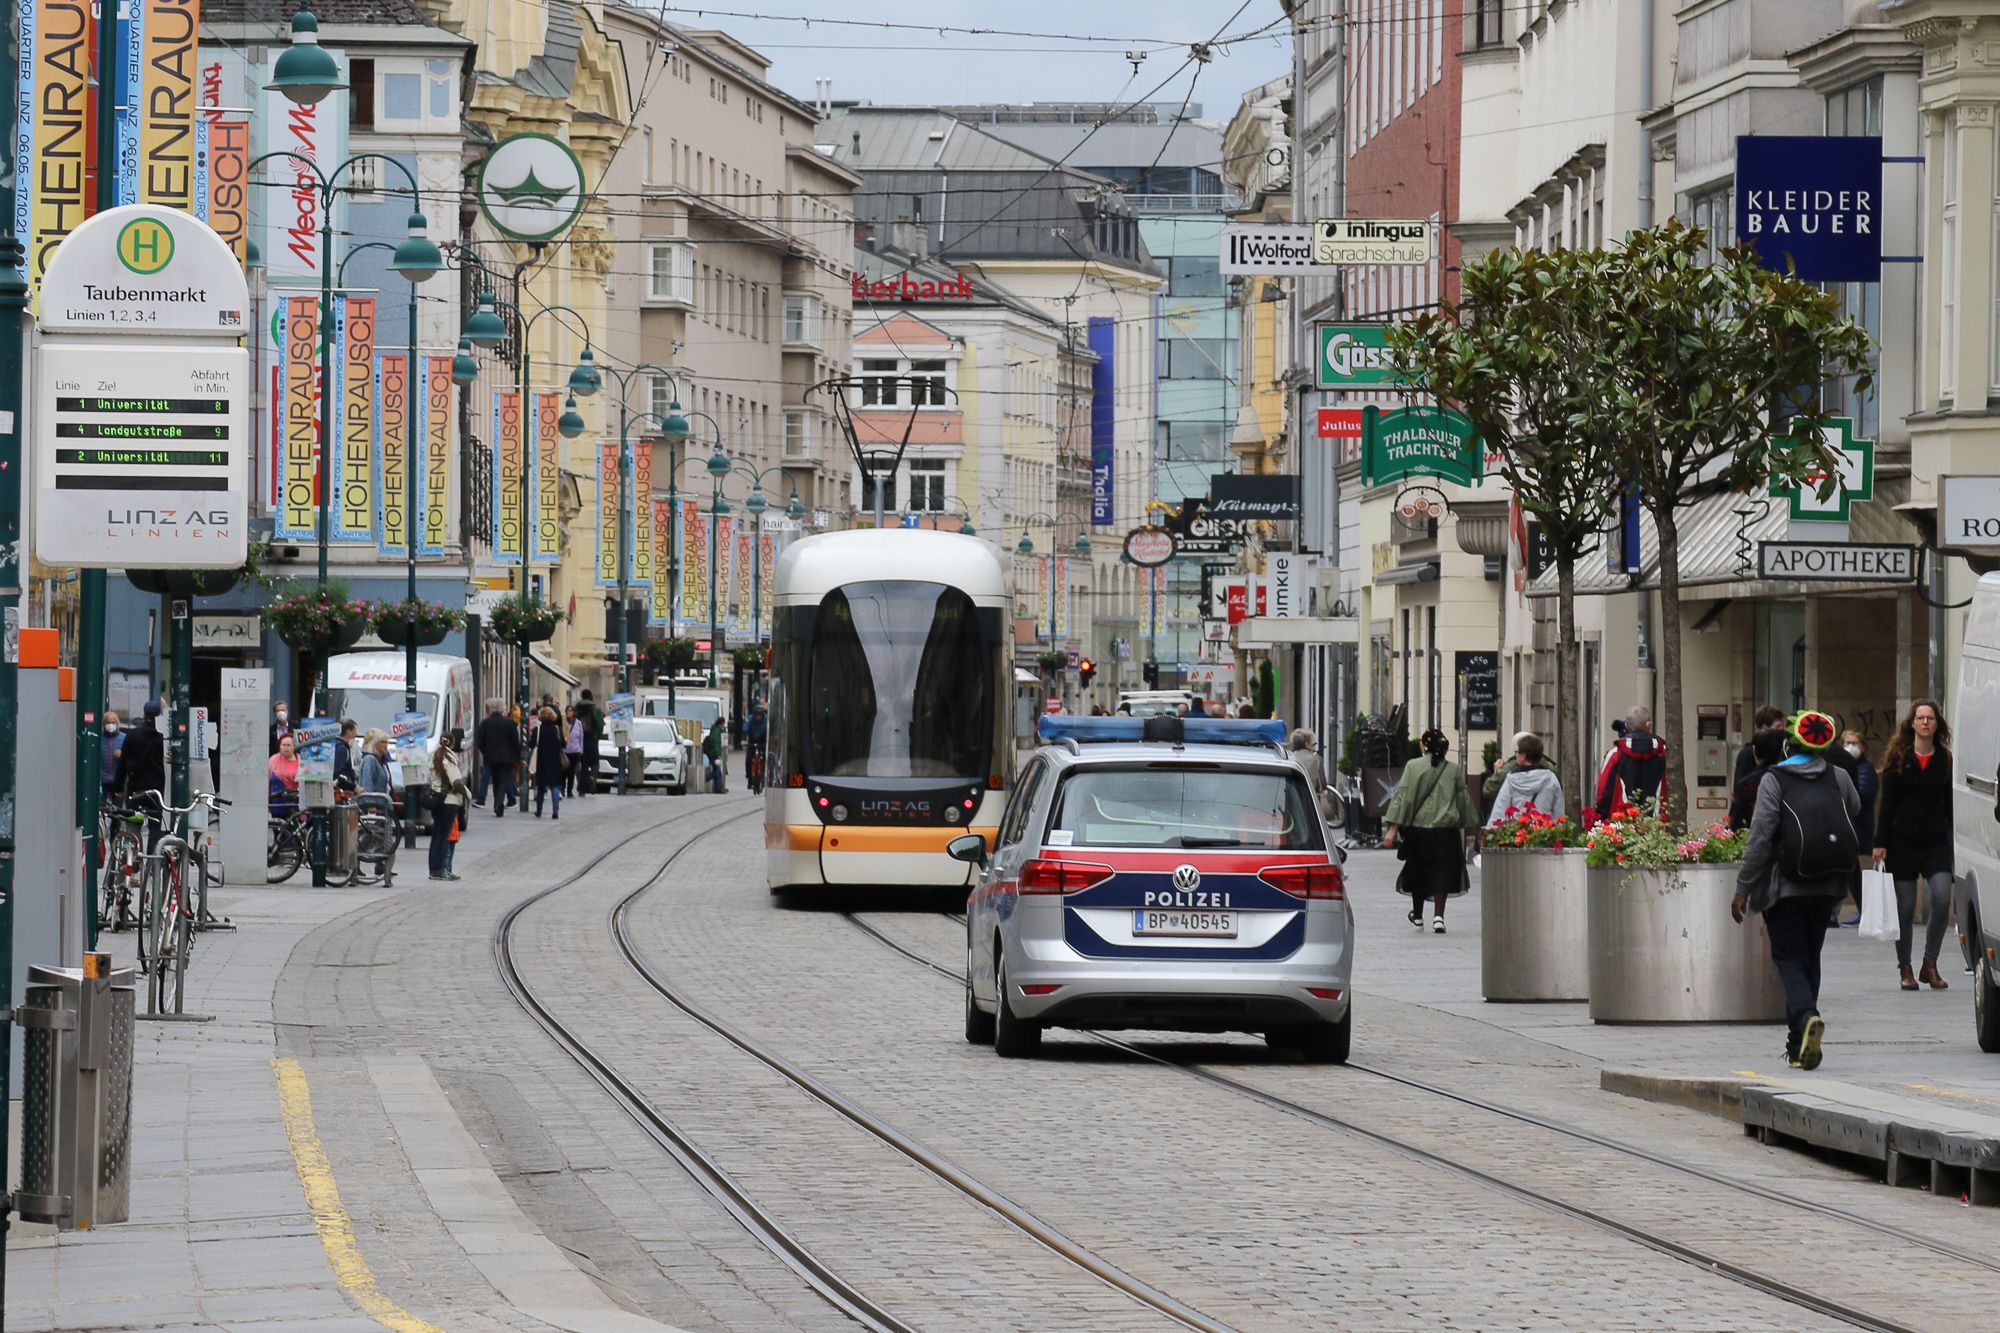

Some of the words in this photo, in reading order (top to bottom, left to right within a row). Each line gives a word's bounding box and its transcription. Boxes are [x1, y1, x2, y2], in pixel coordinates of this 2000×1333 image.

[19, 91, 31, 124] LINZ
[127, 94, 139, 127] LINZ
[18, 134, 30, 176] 06.05.
[126, 137, 138, 180] 06.05.
[16, 187, 28, 233] 17.10.21
[1748, 190, 1871, 211] KLEIDER
[287, 173, 317, 270] Media
[1347, 221, 1424, 242] inlingua
[1748, 213, 1871, 235] BAUER
[133, 228, 158, 262] H
[1248, 243, 1311, 260] Wolford
[1319, 244, 1424, 264] Sprachschule
[83, 284, 207, 303] Taubenmarkt
[66, 309, 105, 321] Linien
[190, 369, 230, 381] Abfahrt
[55, 380, 81, 391] Linie
[97, 381, 117, 391] Ziel
[193, 383, 203, 393] in
[206, 383, 229, 393] Min.
[79, 399, 85, 409] 1
[214, 401, 221, 412] 8
[287, 299, 316, 528] HÖHENRAUSCH
[345, 301, 372, 529] HÖHENRAUSCH
[78, 425, 84, 435] 4
[1322, 421, 1361, 431] Julius
[1383, 427, 1462, 448] THALBAUER
[78, 450, 85, 461] 2
[209, 453, 221, 463] 11
[384, 357, 404, 545] HÖHENRAUSCH
[427, 358, 450, 545] HÖHENRAUSCH
[1387, 443, 1457, 461] TRACHTEN
[501, 395, 519, 552] HÖHENRAUSCH
[540, 395, 557, 553] HÖHENRAUSCH
[1094, 465, 1109, 518] Thalia
[107, 510, 177, 526] LINZ
[185, 510, 229, 526] AG
[602, 444, 618, 580] HÖHENRAUSCH
[636, 443, 650, 580] HÖHENRAUSCH
[107, 528, 229, 538] LINIEN
[1769, 550, 1906, 574] APOTHEKE
[861, 799, 902, 811] LINZ
[906, 799, 930, 811] AG
[1144, 891, 1230, 908] POLIZEI
[1149, 913, 1168, 929] BP
[1181, 914, 1230, 930] 40545
